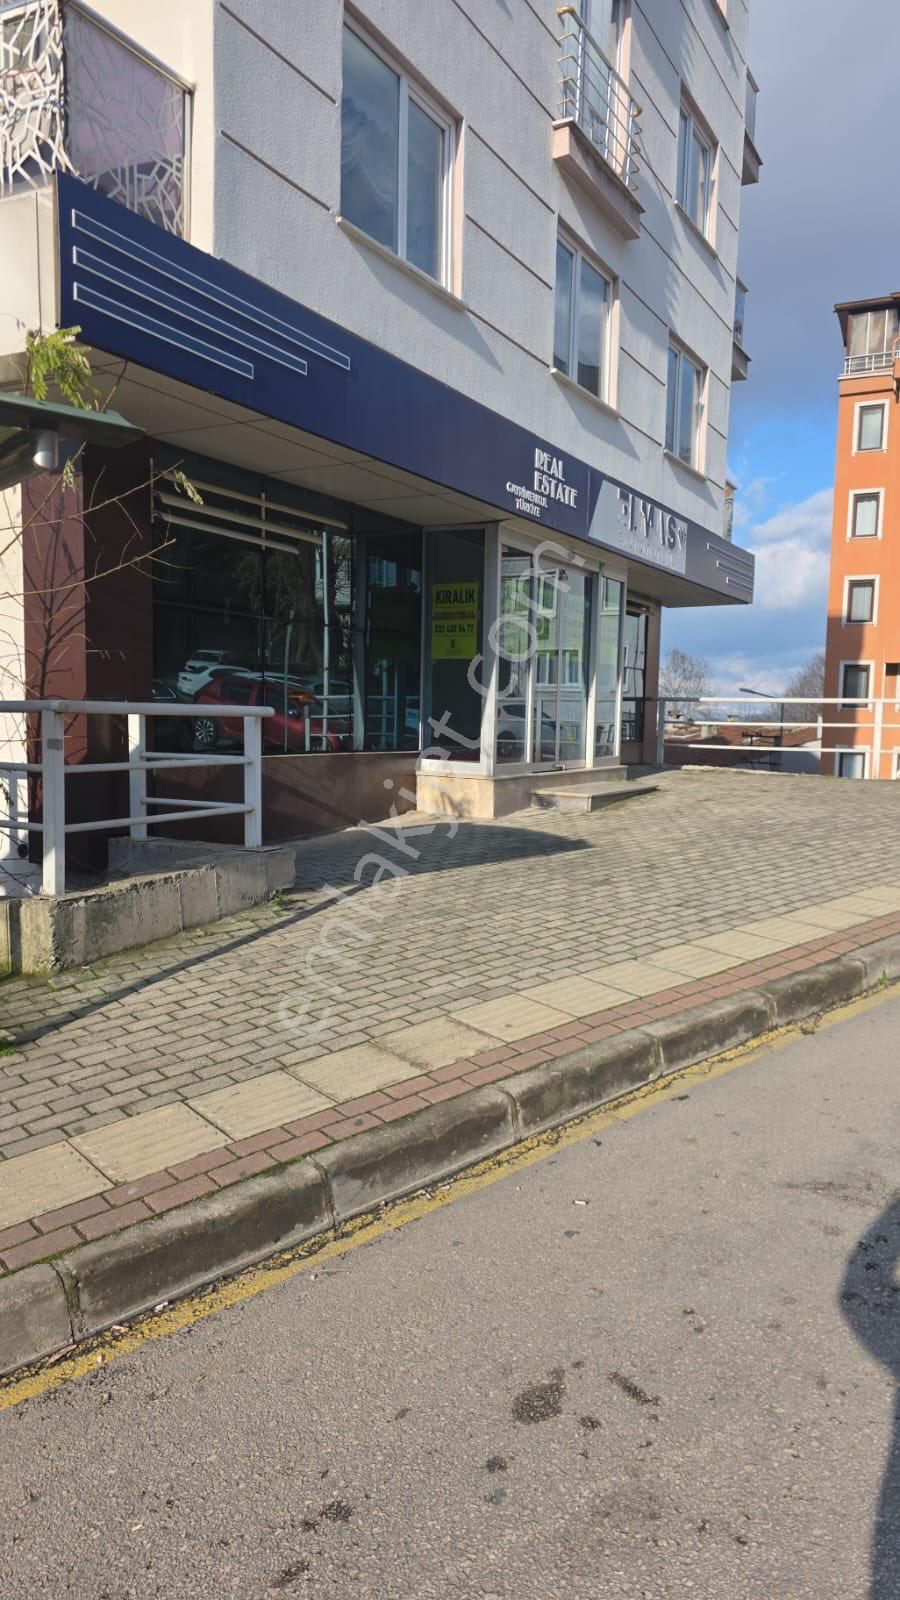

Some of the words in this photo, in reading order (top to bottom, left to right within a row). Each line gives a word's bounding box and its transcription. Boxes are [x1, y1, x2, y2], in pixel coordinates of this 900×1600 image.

[535, 448, 565, 481] REAL
[534, 470, 578, 508] ESTATE
[435, 589, 475, 605] KIRALIK
